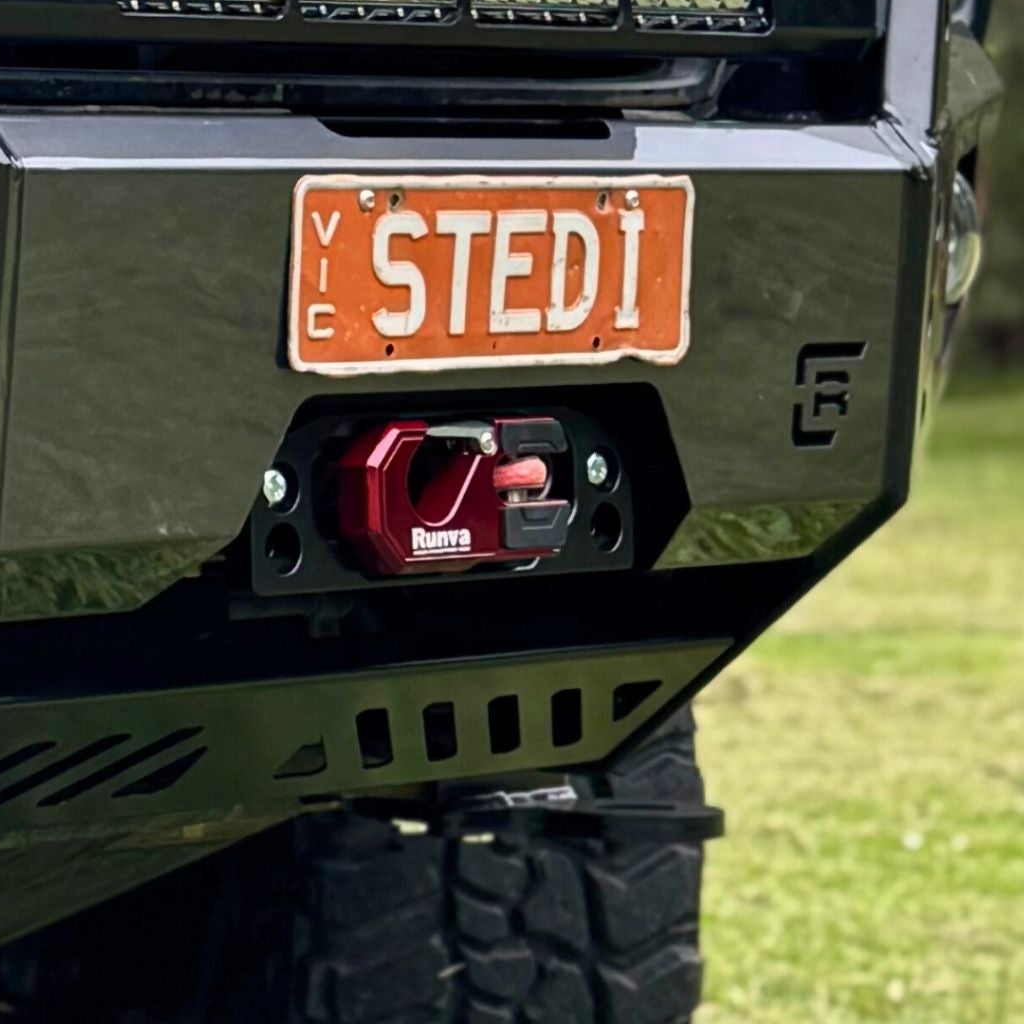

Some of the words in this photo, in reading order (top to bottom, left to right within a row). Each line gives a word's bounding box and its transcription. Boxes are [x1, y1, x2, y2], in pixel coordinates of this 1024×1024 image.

[307, 210, 341, 339] VIC
[372, 208, 646, 337] STEDI
[411, 527, 471, 550] Runva
